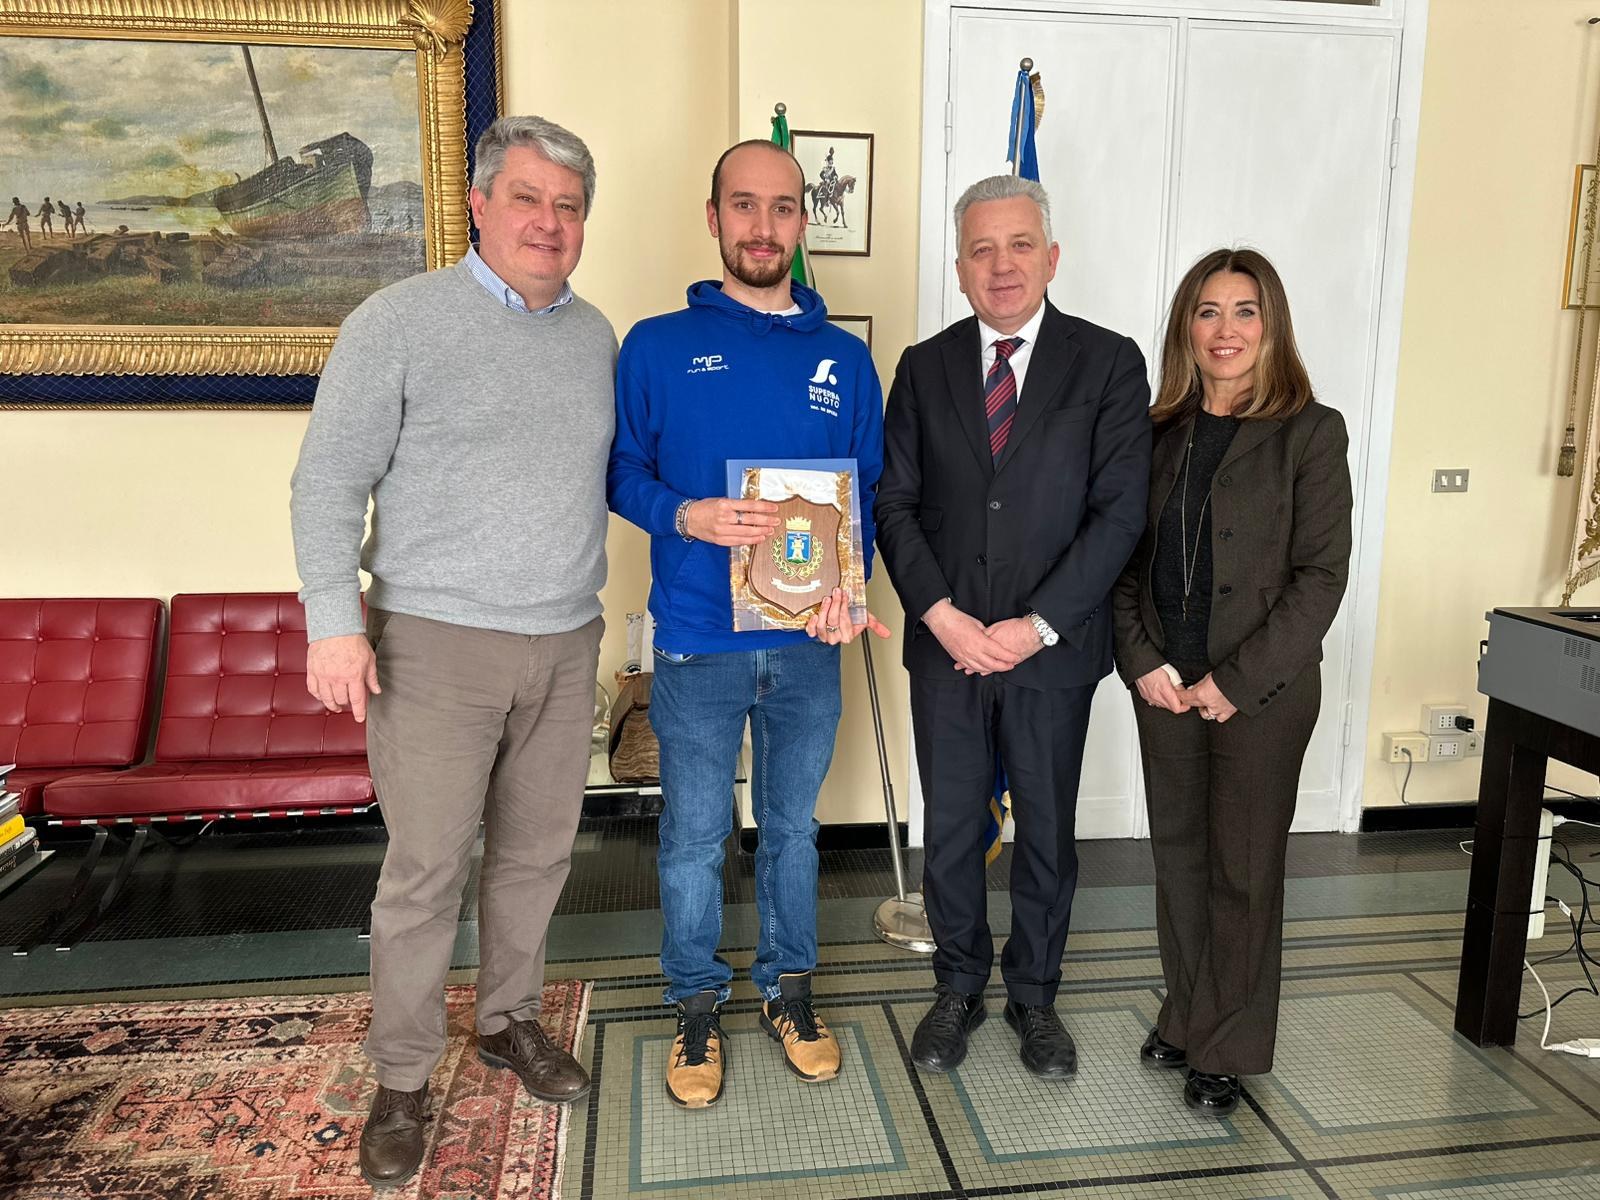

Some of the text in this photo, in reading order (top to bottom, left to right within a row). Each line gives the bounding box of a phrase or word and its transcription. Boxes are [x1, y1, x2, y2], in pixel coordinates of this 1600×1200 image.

[692, 355, 722, 367] MP
[808, 384, 840, 402] SUPERBA
[809, 392, 840, 409] NUOTO
